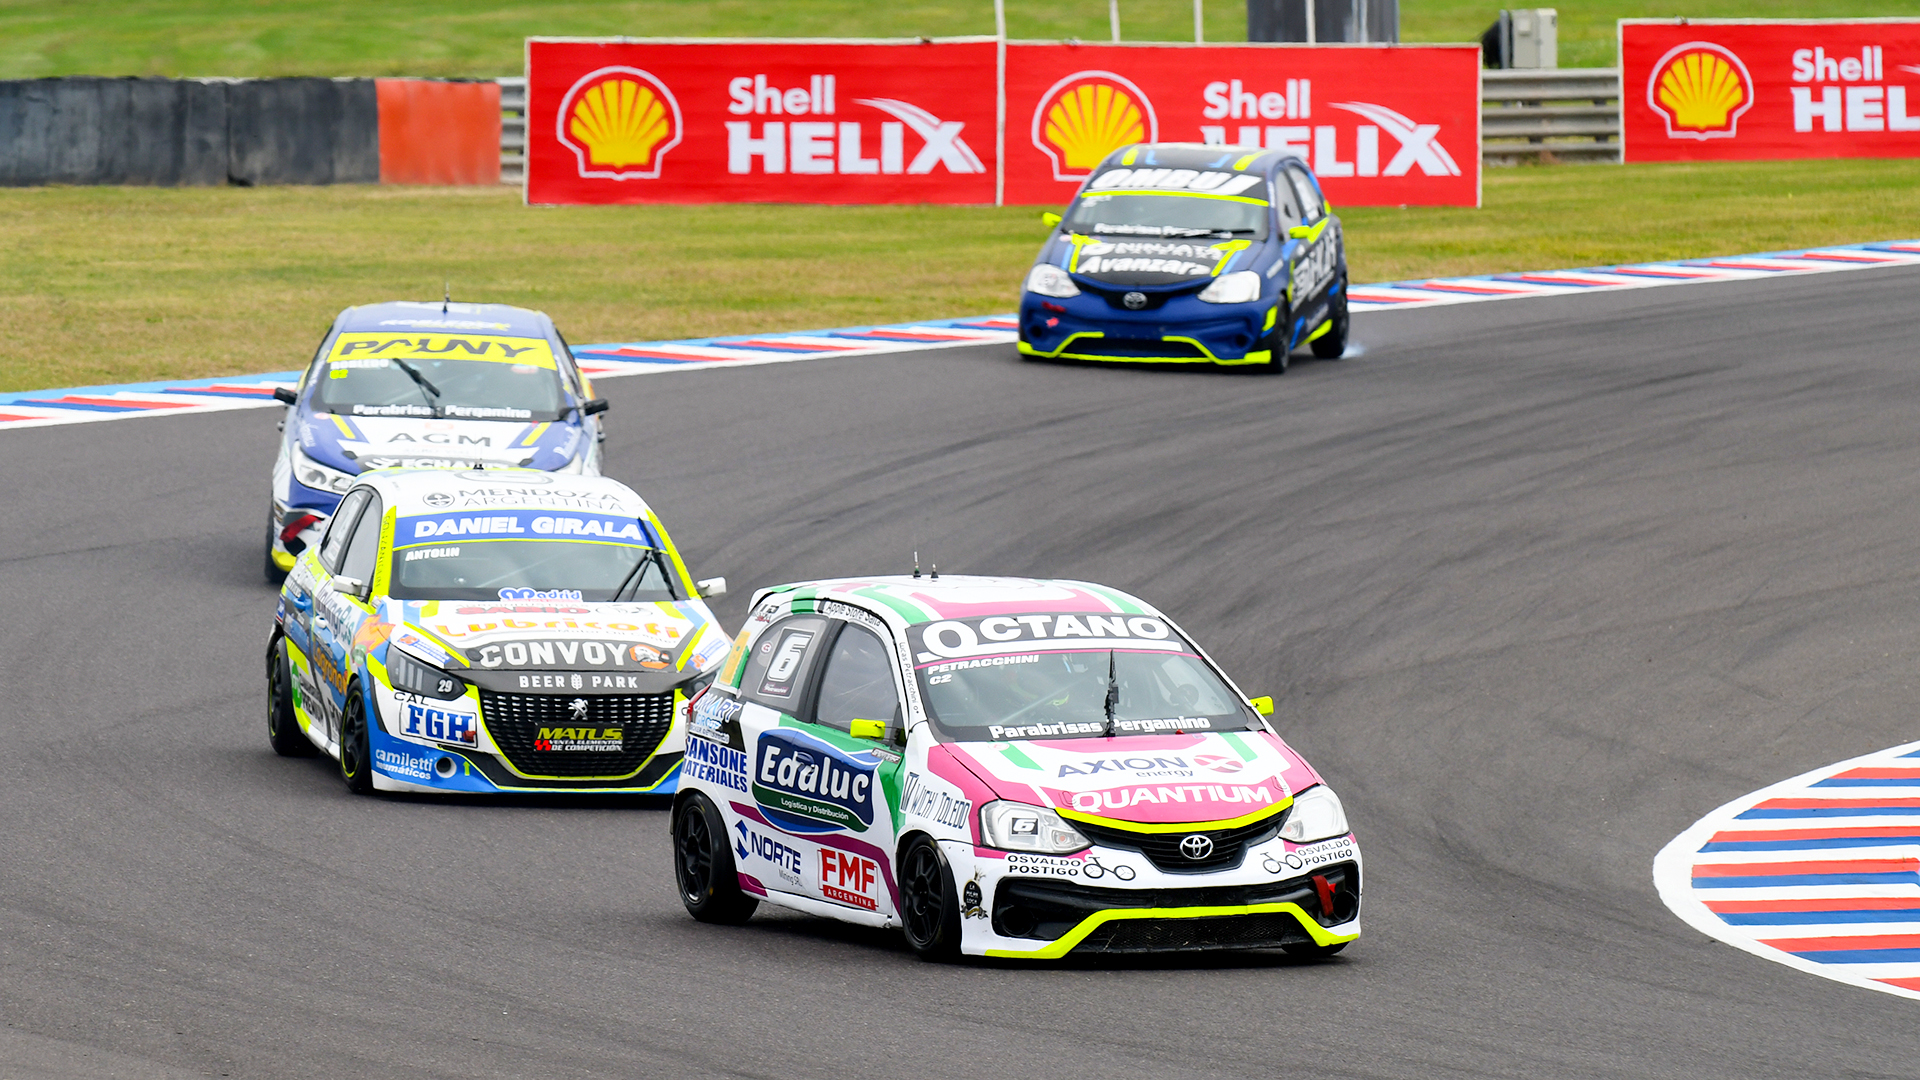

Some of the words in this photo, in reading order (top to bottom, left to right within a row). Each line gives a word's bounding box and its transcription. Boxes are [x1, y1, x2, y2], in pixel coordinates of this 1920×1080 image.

[1792, 46, 1883, 82] Shell
[728, 75, 836, 115] Shell
[1203, 79, 1311, 120] Shell
[725, 100, 986, 174] HELIX
[339, 338, 538, 358] PAUNY
[444, 405, 532, 419] Pergamino
[387, 432, 492, 447] AGM
[458, 488, 621, 502] MENDOZA
[464, 497, 627, 512] ARGENTINA
[414, 517, 525, 538] DANIEL
[530, 517, 643, 541] GIRALA
[405, 547, 460, 562] ANTOLIN
[499, 587, 581, 601] Madrid
[826, 601, 846, 617] Apple
[846, 607, 865, 621] Store
[480, 641, 629, 668] CONVOY
[767, 632, 812, 682] 6
[899, 641, 908, 662] Lucas
[927, 655, 1040, 675] PETRACCHINI
[437, 679, 453, 693] 29
[519, 675, 566, 688] BEER
[592, 675, 638, 689] PARK
[929, 674, 952, 686] C2
[394, 691, 429, 706] CAL
[405, 704, 475, 744] FGH
[537, 727, 624, 740] MATUS
[989, 722, 1104, 739] Parabrisas
[564, 744, 623, 752] COMPETICIÓN
[375, 749, 433, 772] camiletti
[1057, 757, 1189, 778] AXION
[1136, 768, 1194, 779] energy
[781, 797, 808, 812] Logística
[813, 806, 849, 821] Distribución
[1071, 786, 1273, 813] QUANTIUM
[933, 791, 971, 830] TOLEDO
[1012, 818, 1037, 832] 6
[751, 831, 801, 875] NORTE
[1297, 838, 1351, 856] OSVALDO
[1304, 848, 1353, 866] POSTIGO
[820, 848, 876, 894] FMF
[1007, 855, 1081, 867] OSVALDO
[1008, 865, 1079, 877] POSTIGO
[827, 886, 873, 908] ARGENTINA
